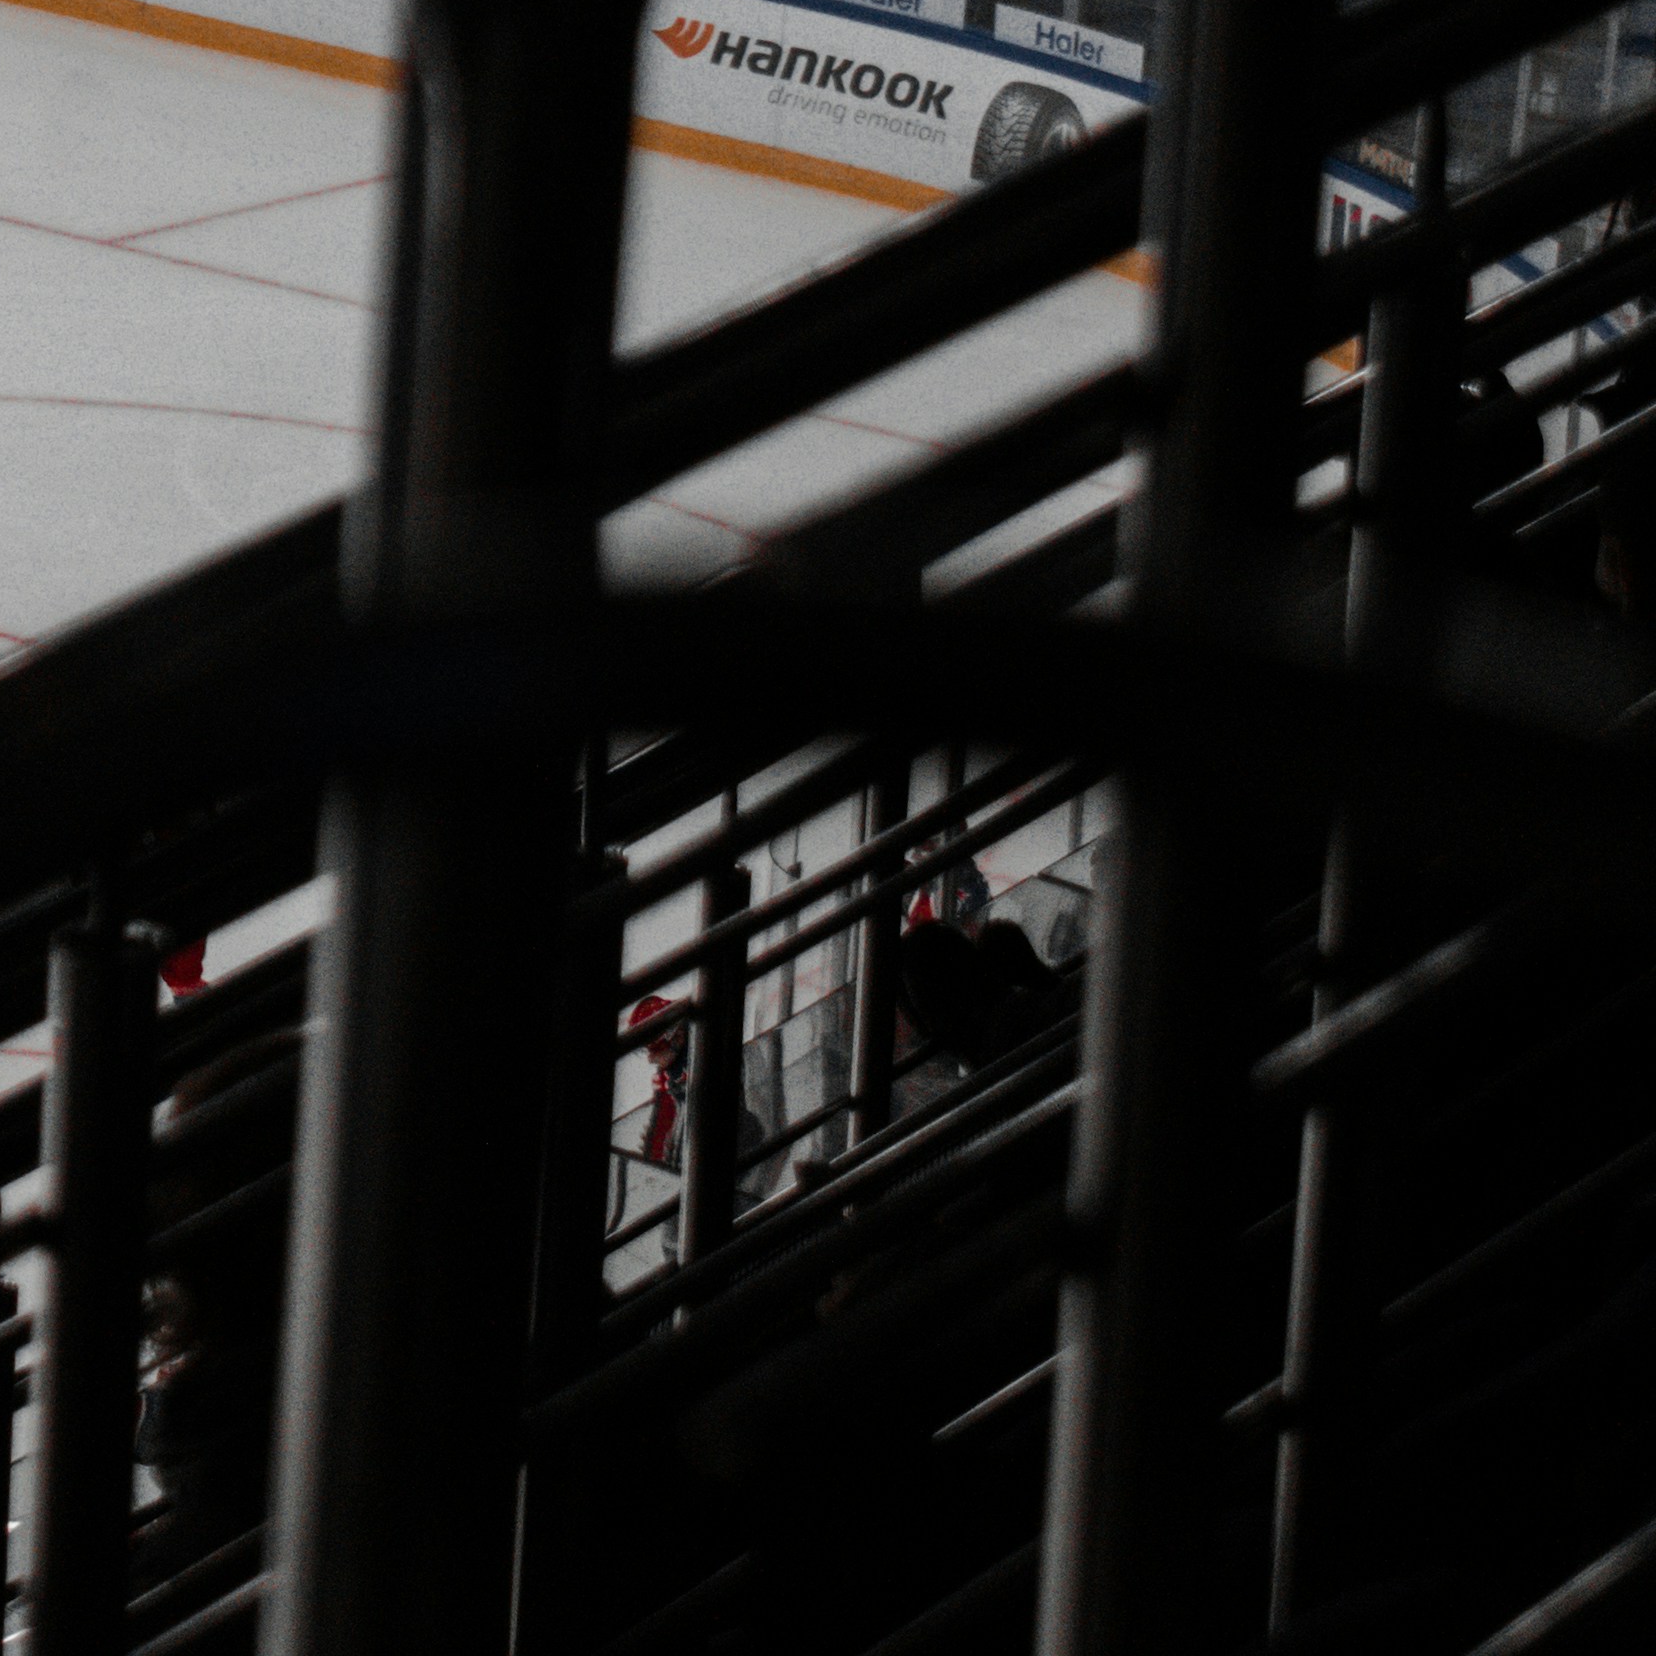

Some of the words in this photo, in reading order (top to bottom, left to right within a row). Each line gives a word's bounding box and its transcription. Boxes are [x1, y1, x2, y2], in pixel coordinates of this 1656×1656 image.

[1035, 20, 1106, 65] Haier
[767, 84, 847, 124] driving
[853, 108, 948, 145] emotion
